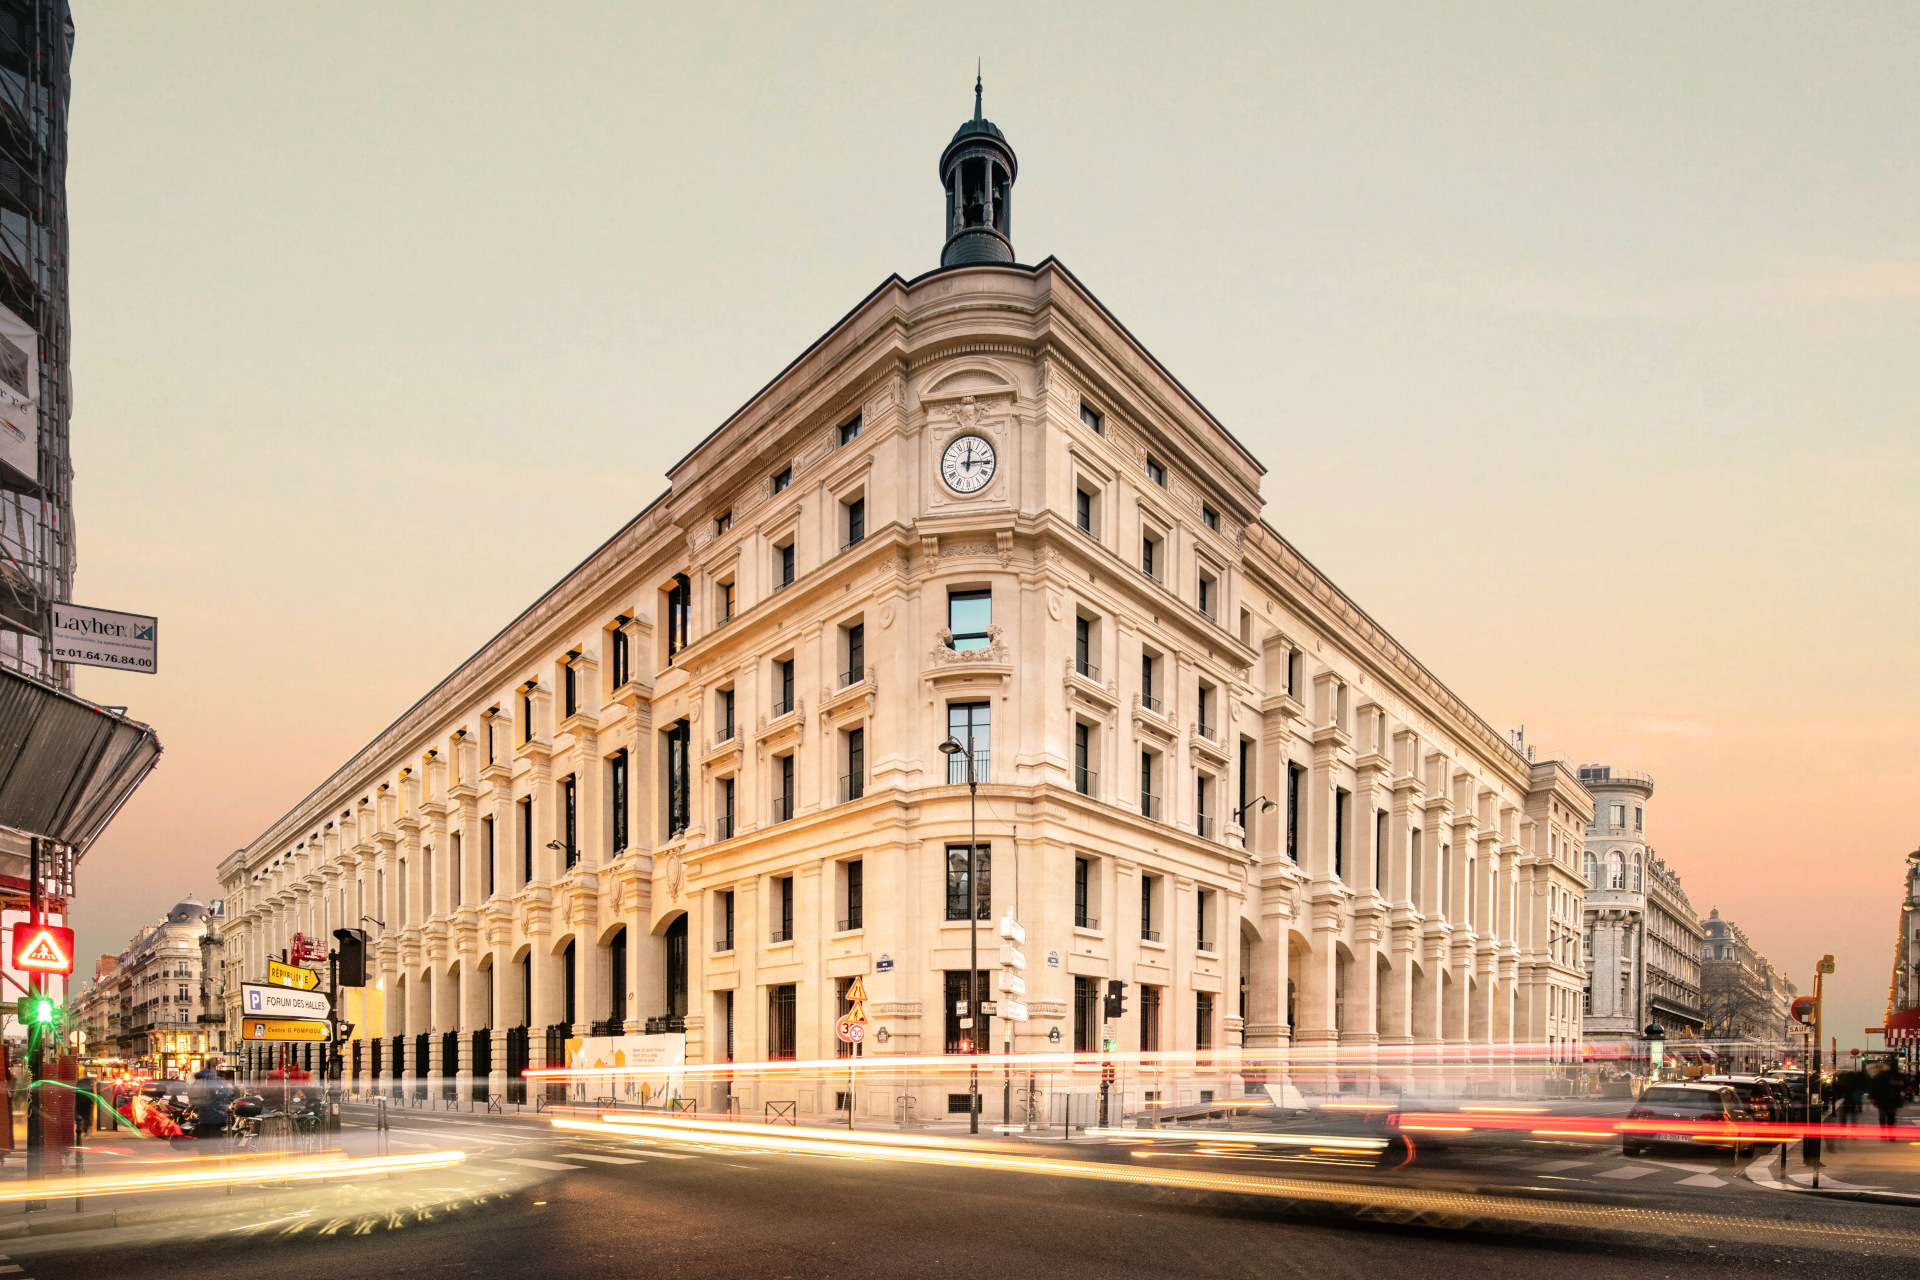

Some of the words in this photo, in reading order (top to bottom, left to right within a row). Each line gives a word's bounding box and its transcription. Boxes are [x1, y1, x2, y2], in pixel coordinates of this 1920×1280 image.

[68, 648, 152, 668] 01.64.76.84.00
[266, 996, 292, 1007] FORUM
[293, 998, 305, 1008] DES
[305, 999, 325, 1011] HALLES
[852, 1029, 862, 1038] 30
